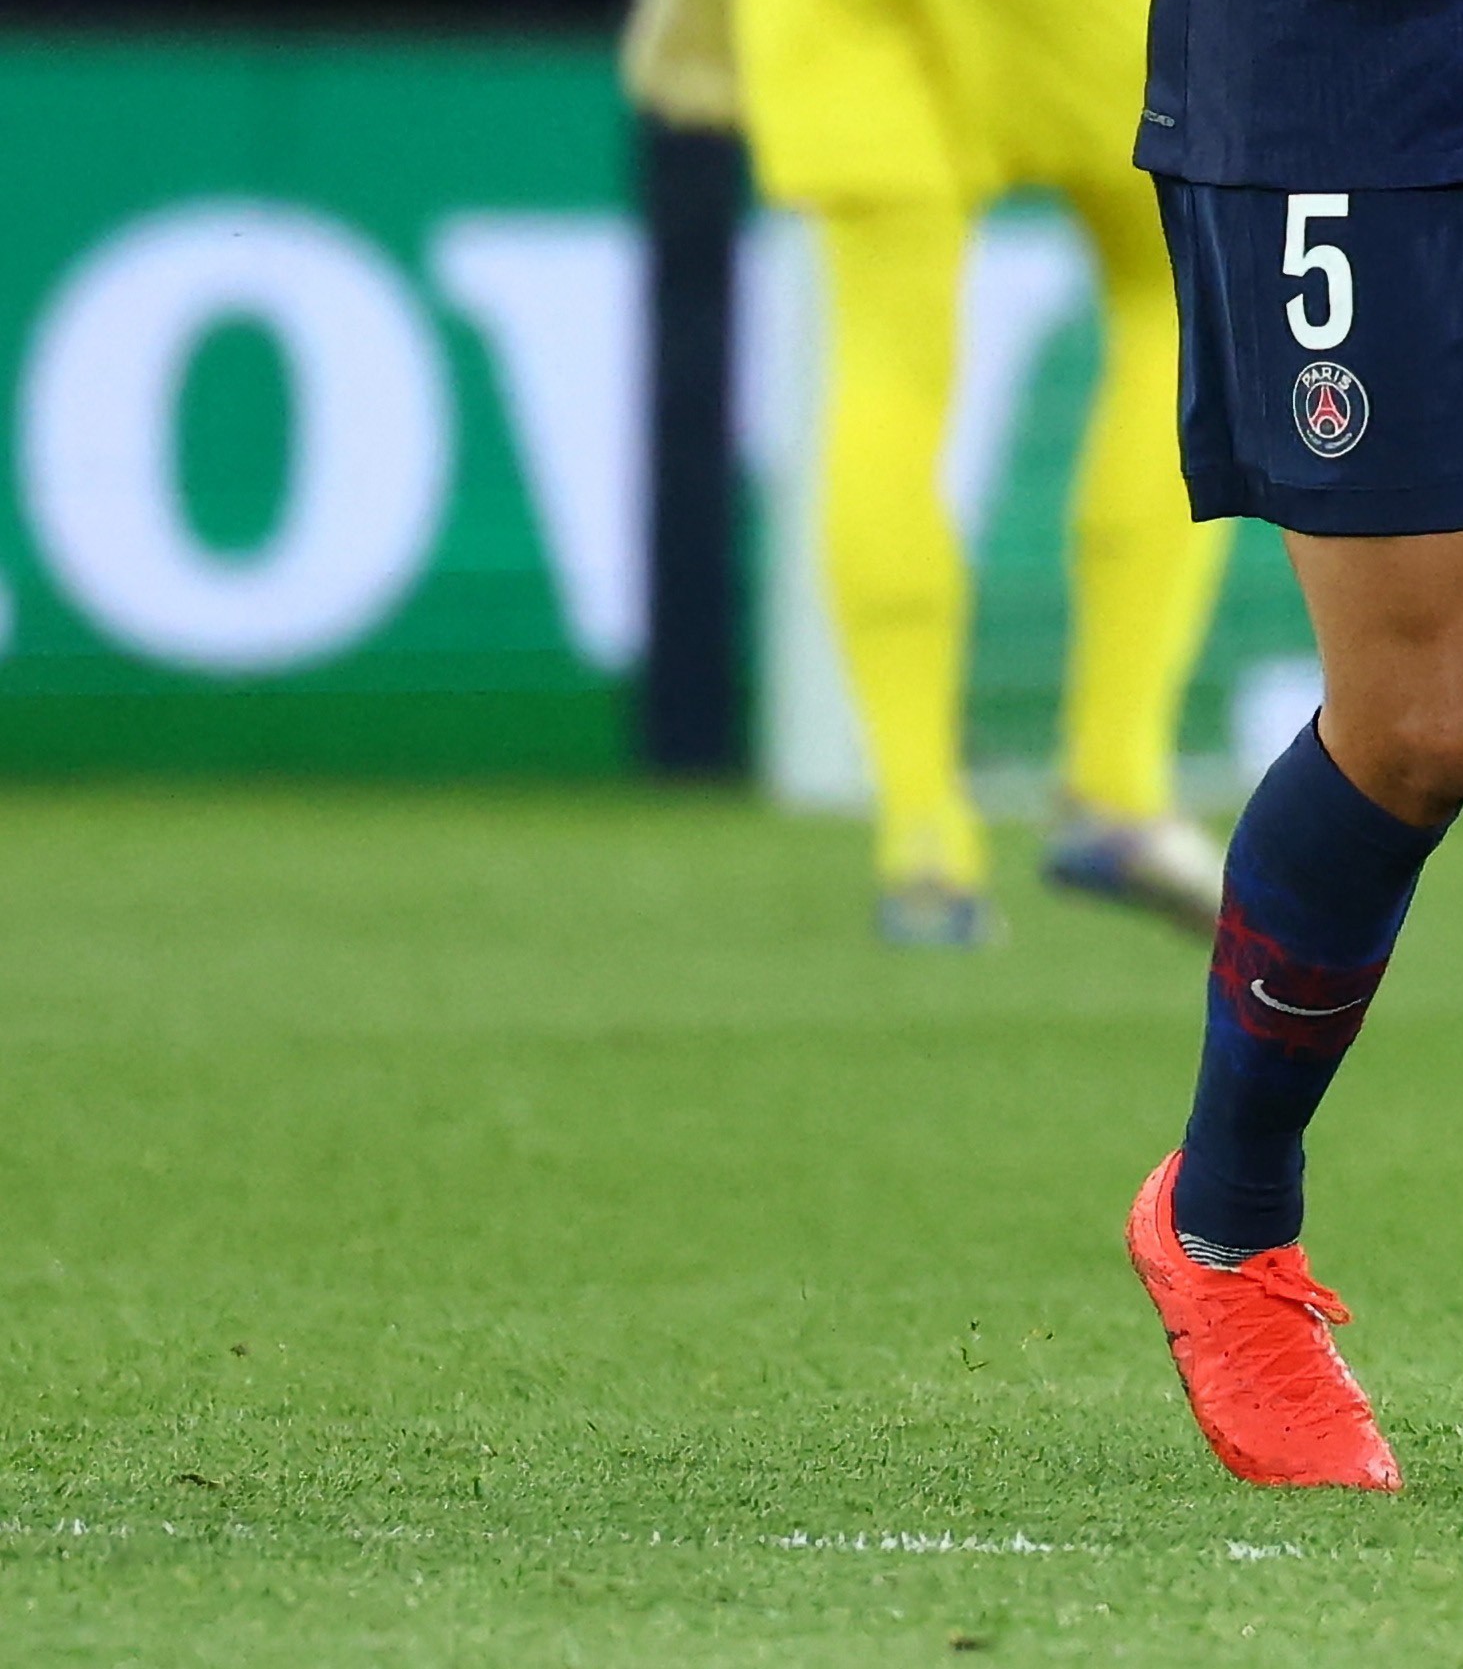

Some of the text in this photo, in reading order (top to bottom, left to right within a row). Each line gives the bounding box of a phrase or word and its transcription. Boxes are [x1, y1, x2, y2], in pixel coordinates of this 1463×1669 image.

[1283, 194, 1353, 350] 5
[0, 200, 1100, 674] ow
[1302, 367, 1352, 390] PARIS
